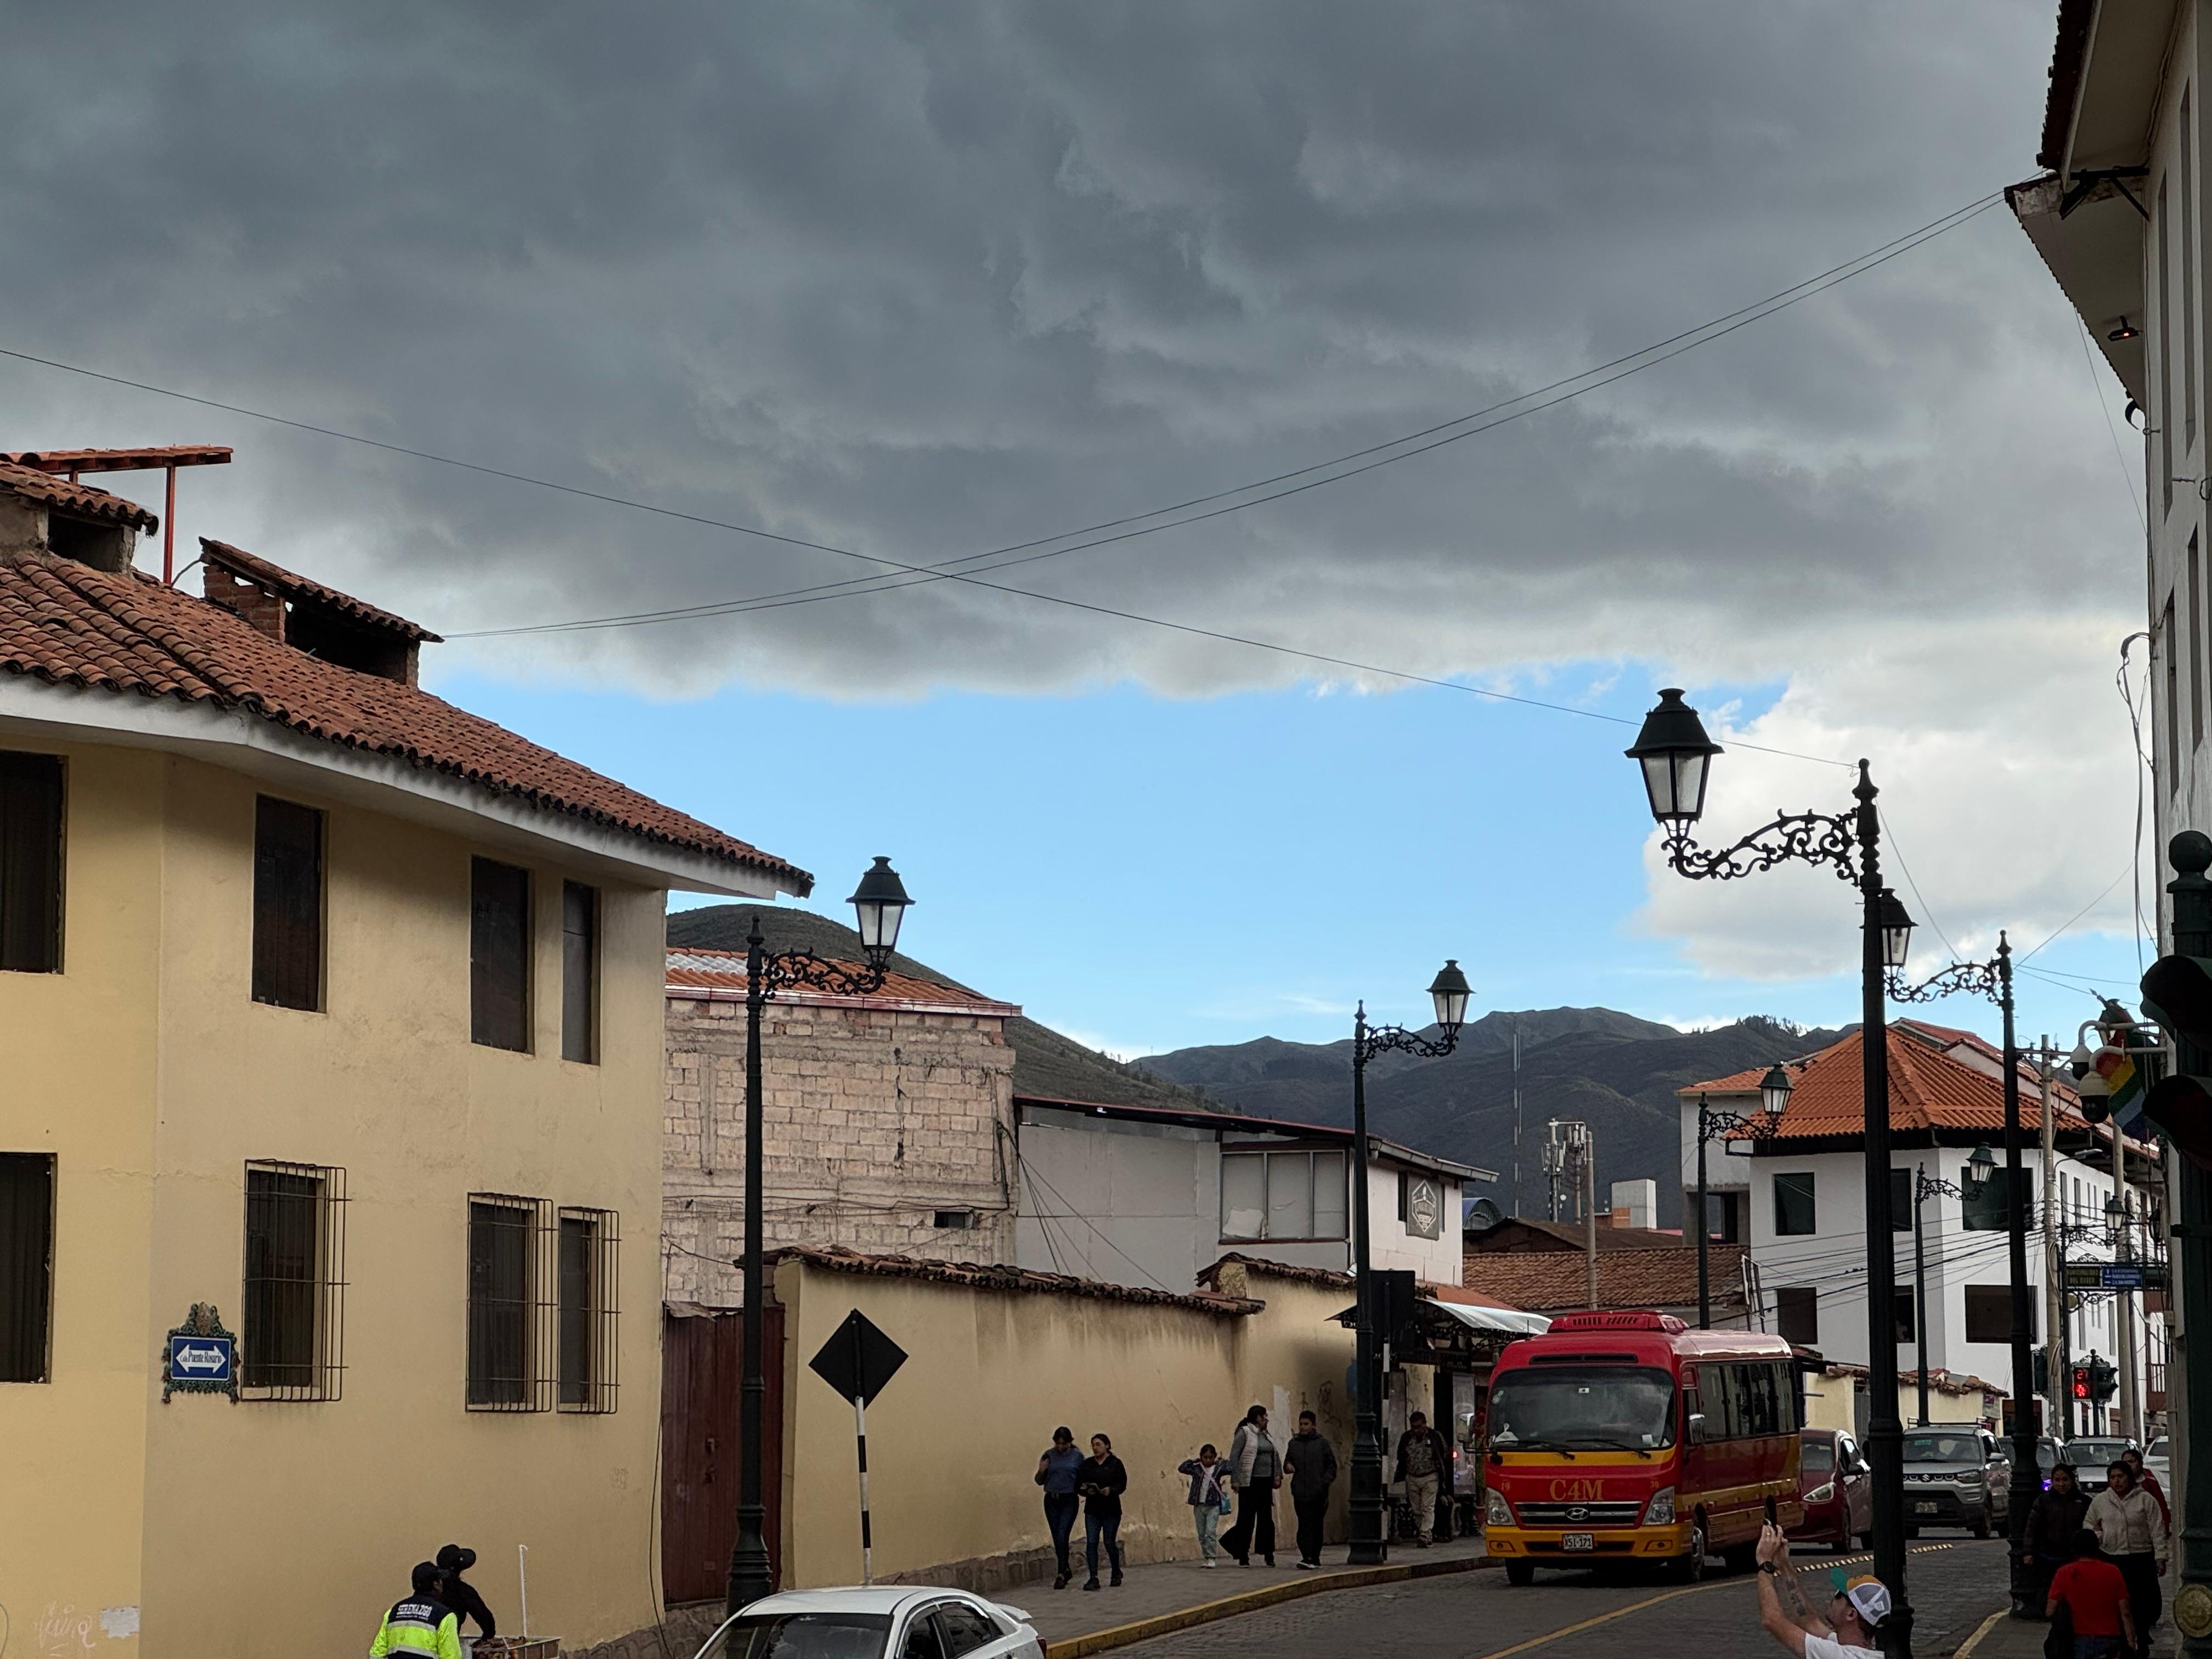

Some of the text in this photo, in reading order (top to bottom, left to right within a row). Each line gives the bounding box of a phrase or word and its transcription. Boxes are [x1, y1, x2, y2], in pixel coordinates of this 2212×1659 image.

[188, 1351, 204, 1363] Puente
[204, 1351, 222, 1364] Rosario
[1550, 1479, 1604, 1501] C4M
[396, 1604, 433, 1618] SERENAZGO
